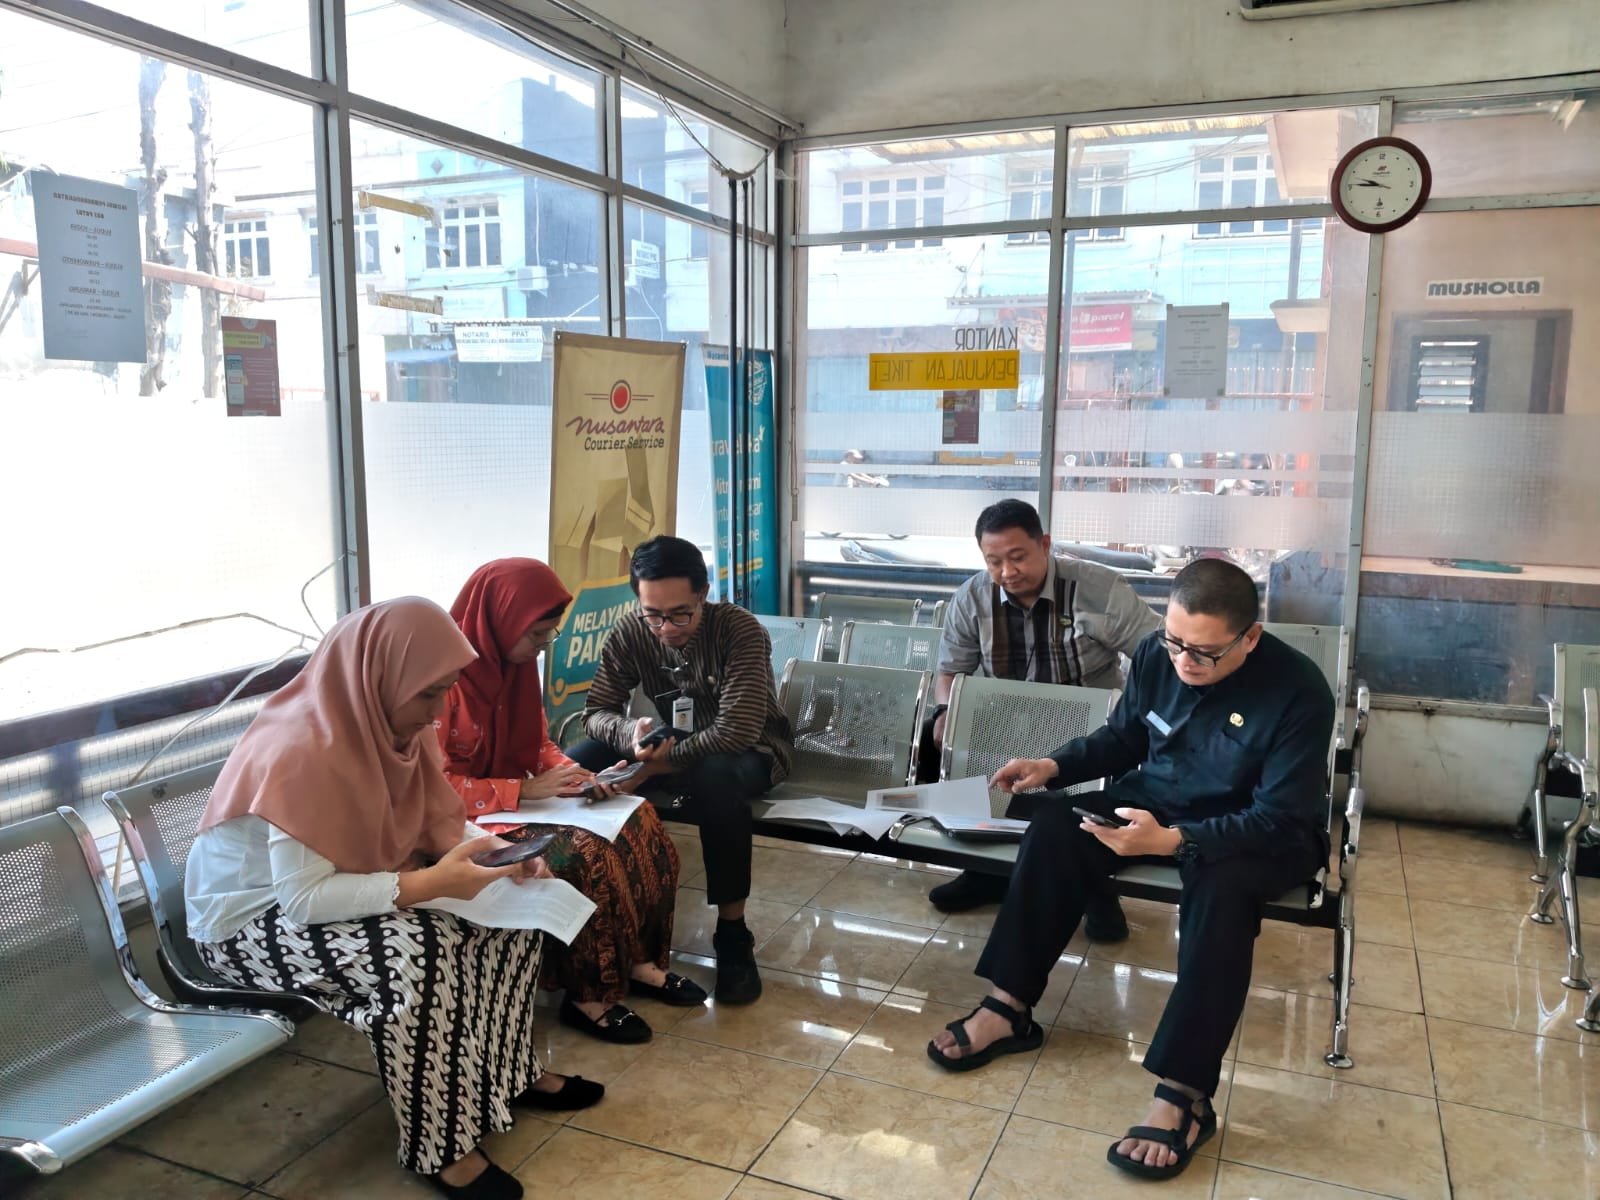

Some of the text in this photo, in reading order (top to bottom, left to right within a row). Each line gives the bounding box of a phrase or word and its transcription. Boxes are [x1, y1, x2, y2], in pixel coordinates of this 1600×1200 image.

[1428, 280, 1541, 296] MUSHOLLA
[584, 435, 665, 451] Courier Service
[572, 600, 638, 634] MELAYAN
[566, 629, 610, 668] PAK
